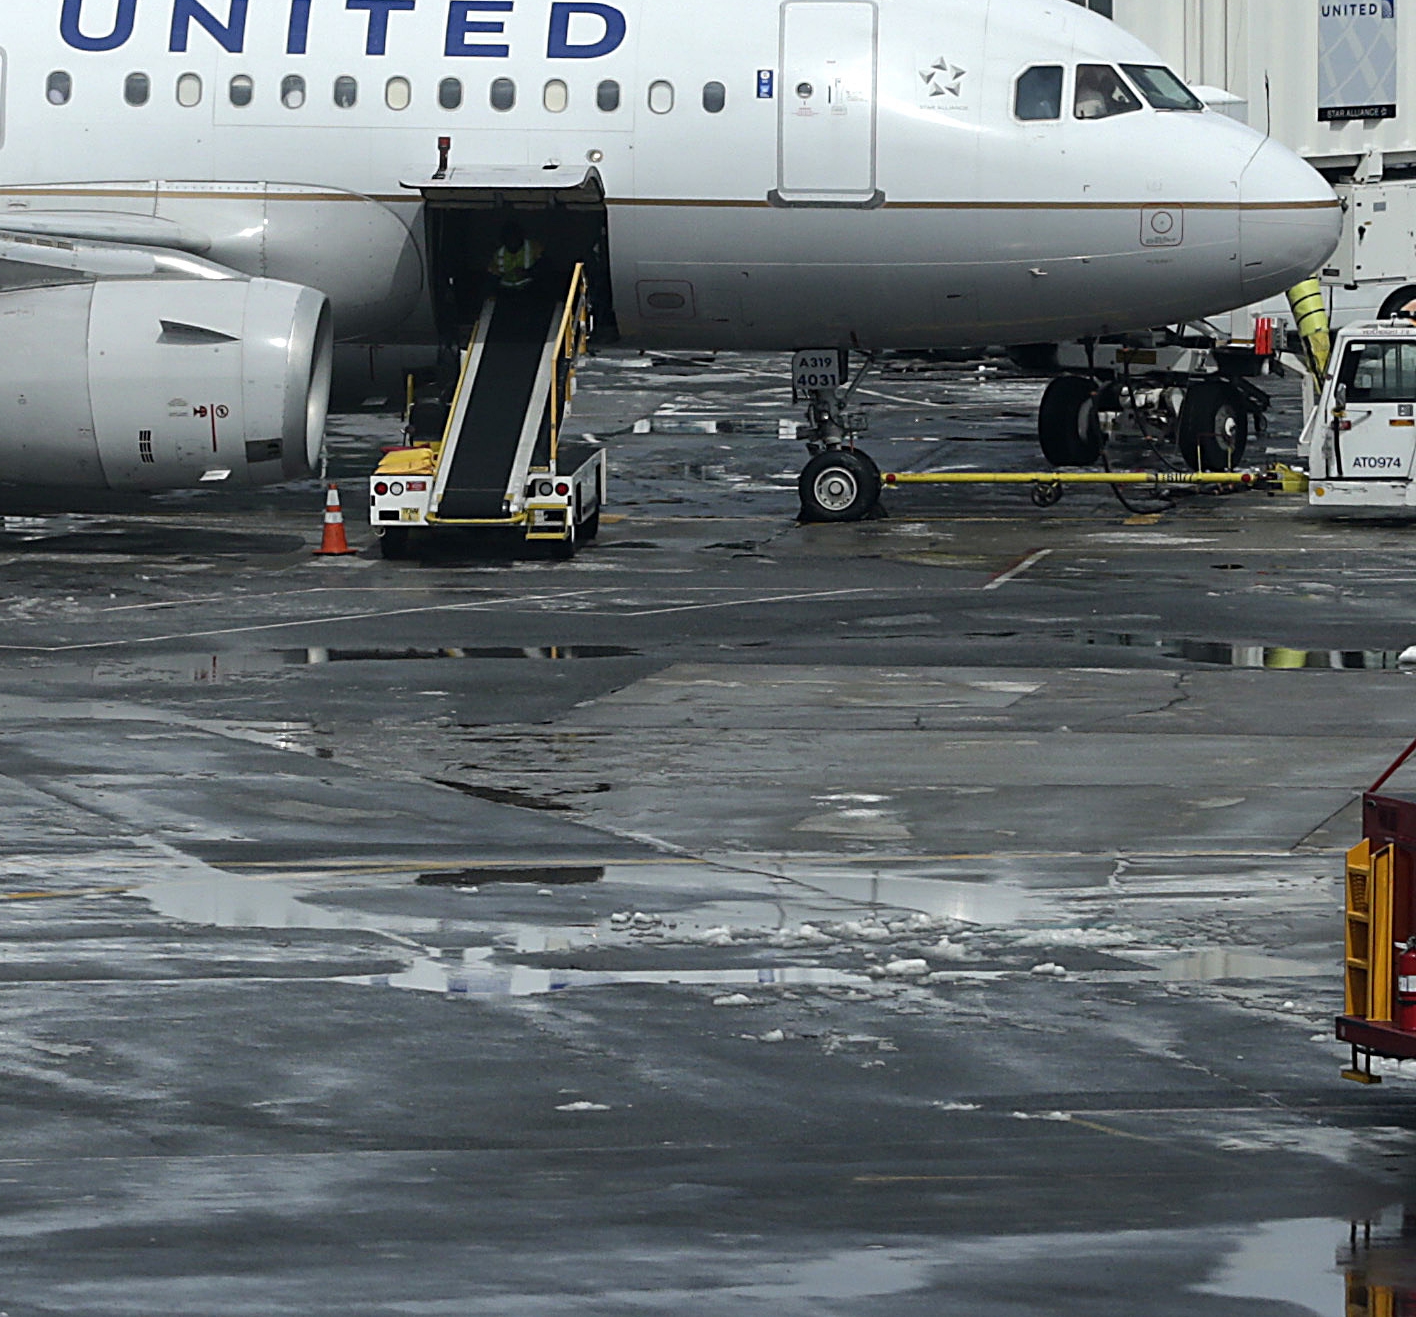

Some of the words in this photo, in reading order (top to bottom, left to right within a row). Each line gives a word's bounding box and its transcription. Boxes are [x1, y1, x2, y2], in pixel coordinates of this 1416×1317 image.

[1321, 3, 1378, 17] UNITED
[799, 357, 833, 367] A319
[797, 374, 836, 386] 4031
